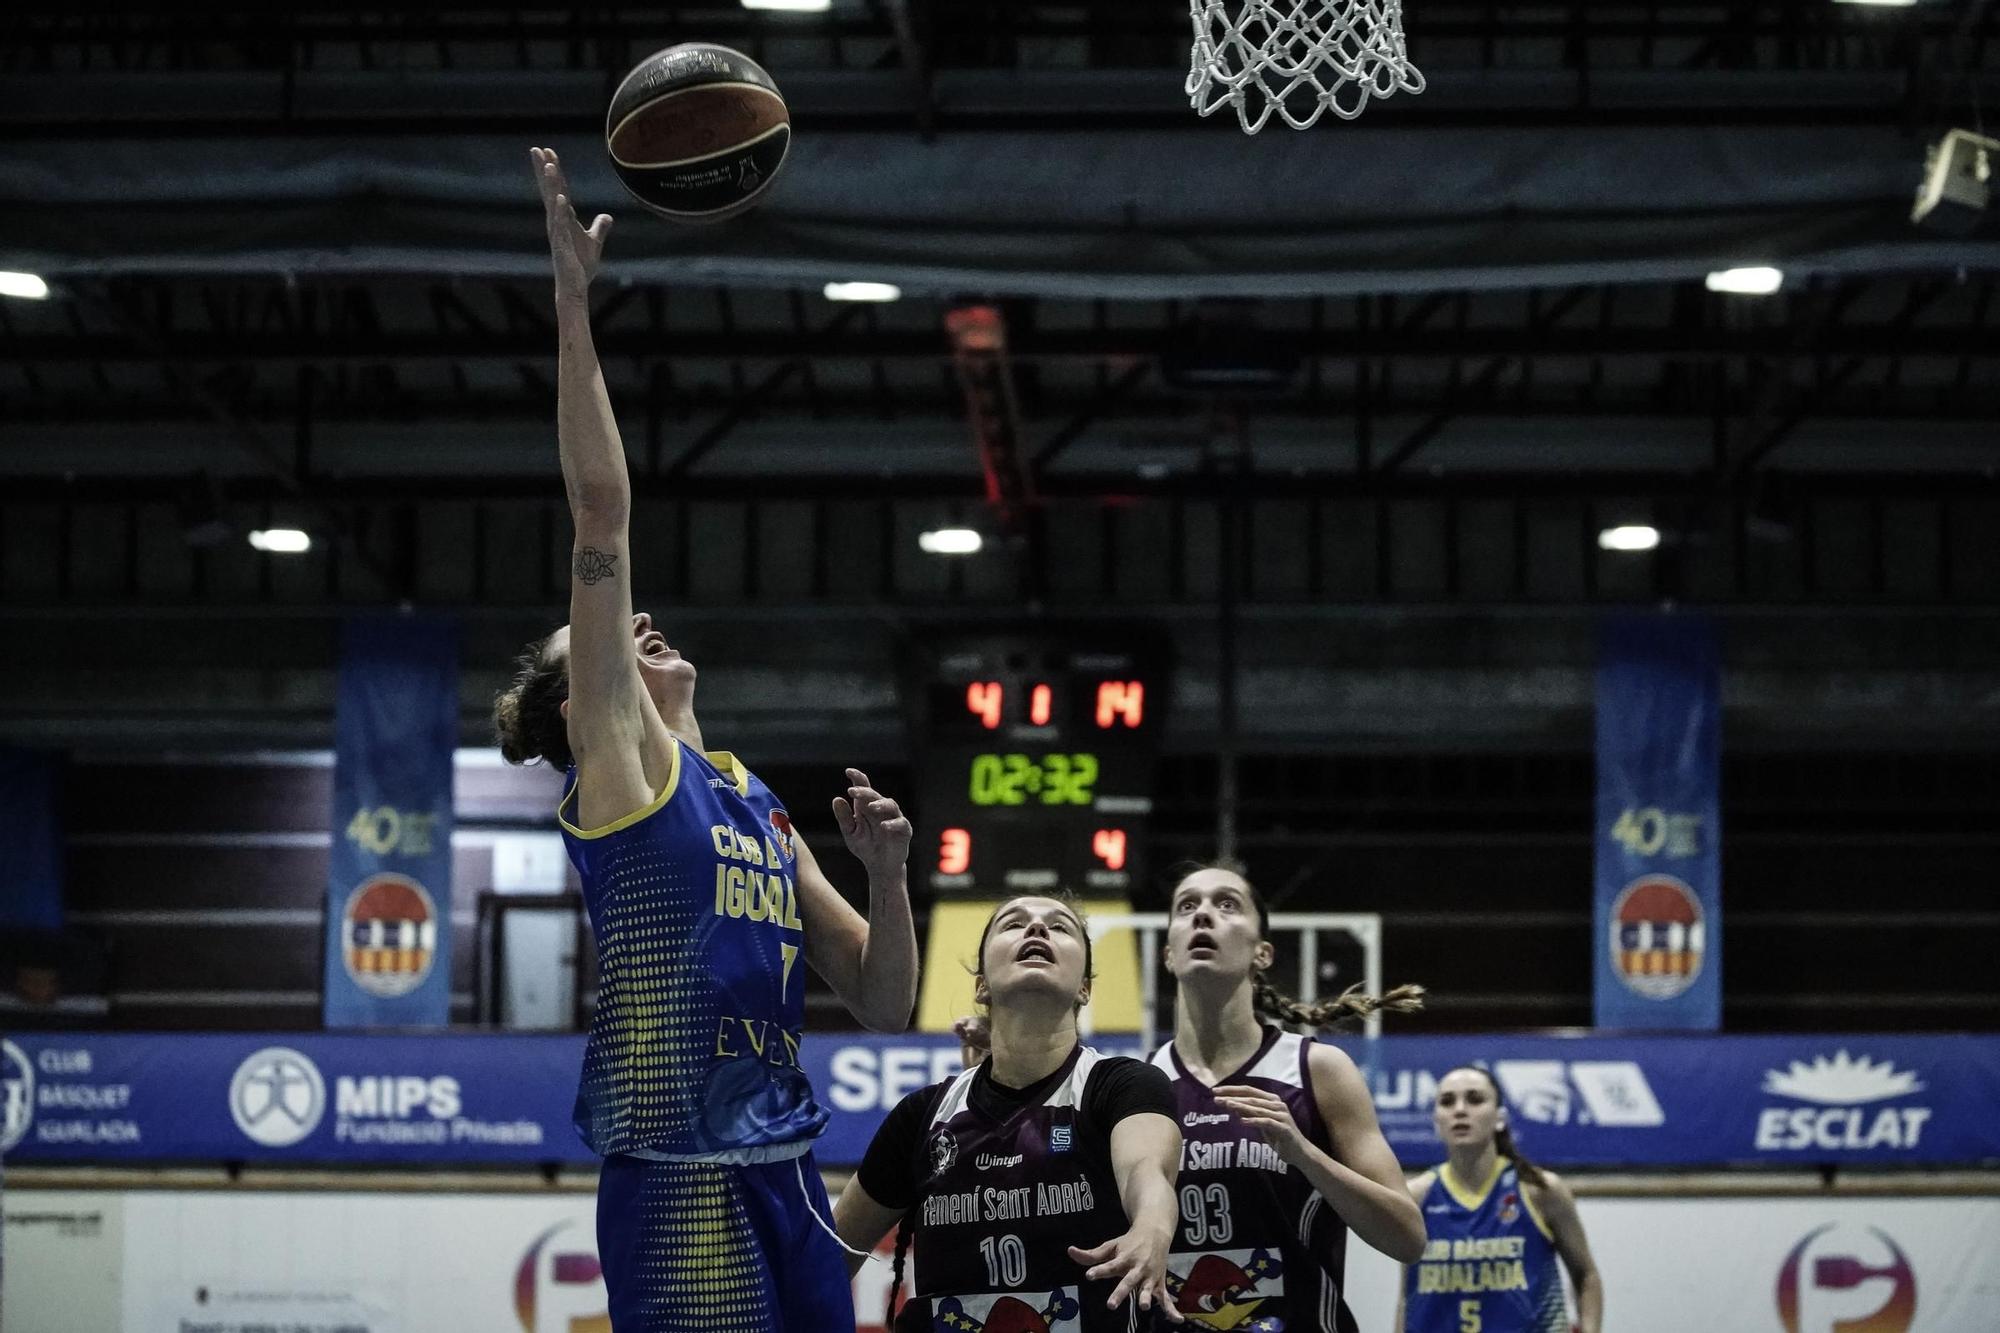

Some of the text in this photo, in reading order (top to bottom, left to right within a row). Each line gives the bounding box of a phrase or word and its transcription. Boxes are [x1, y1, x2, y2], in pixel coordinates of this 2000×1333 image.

[966, 680, 1002, 730] 4
[1030, 682, 1052, 726] 1
[1095, 680, 1144, 729] 14
[969, 753, 1099, 806] 02:32
[346, 806, 400, 855] 40
[938, 827, 971, 874] 3
[1092, 828, 1126, 871] 4
[1611, 808, 1667, 857] 40
[780, 941, 799, 1005] 7
[335, 1076, 462, 1119] MIPS
[1755, 1107, 1932, 1151] ESCLAT
[1180, 1183, 1233, 1246] 93
[979, 1233, 1027, 1288] 10
